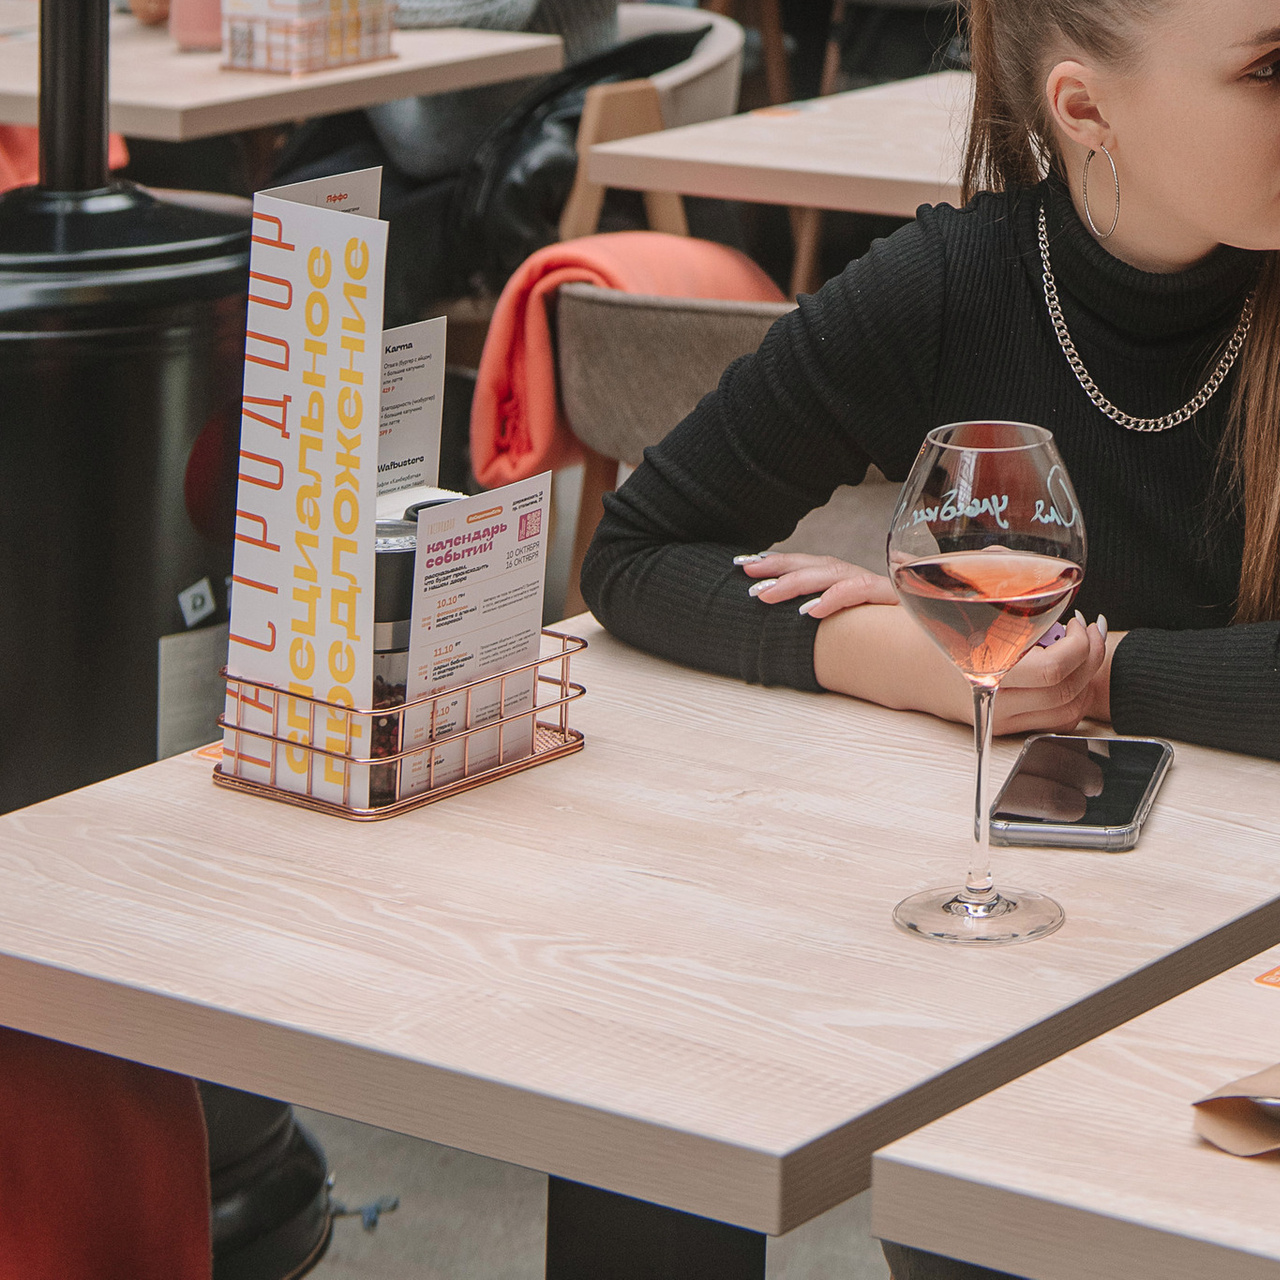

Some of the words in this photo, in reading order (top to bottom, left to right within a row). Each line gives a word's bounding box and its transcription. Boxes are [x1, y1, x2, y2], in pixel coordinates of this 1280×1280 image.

[385, 342, 413, 354] Karma
[285, 246, 332, 774] специальное
[324, 237, 369, 787] предложение
[427, 523, 507, 554] календарь
[426, 539, 493, 568] событий
[505, 559, 513, 569] 16
[513, 551, 539, 566] ОКТЯБРЯ
[506, 550, 514, 560] 10
[514, 541, 540, 556] ОКТЯБРЯ
[436, 595, 457, 609] 10.10
[433, 643, 454, 658] 11.10
